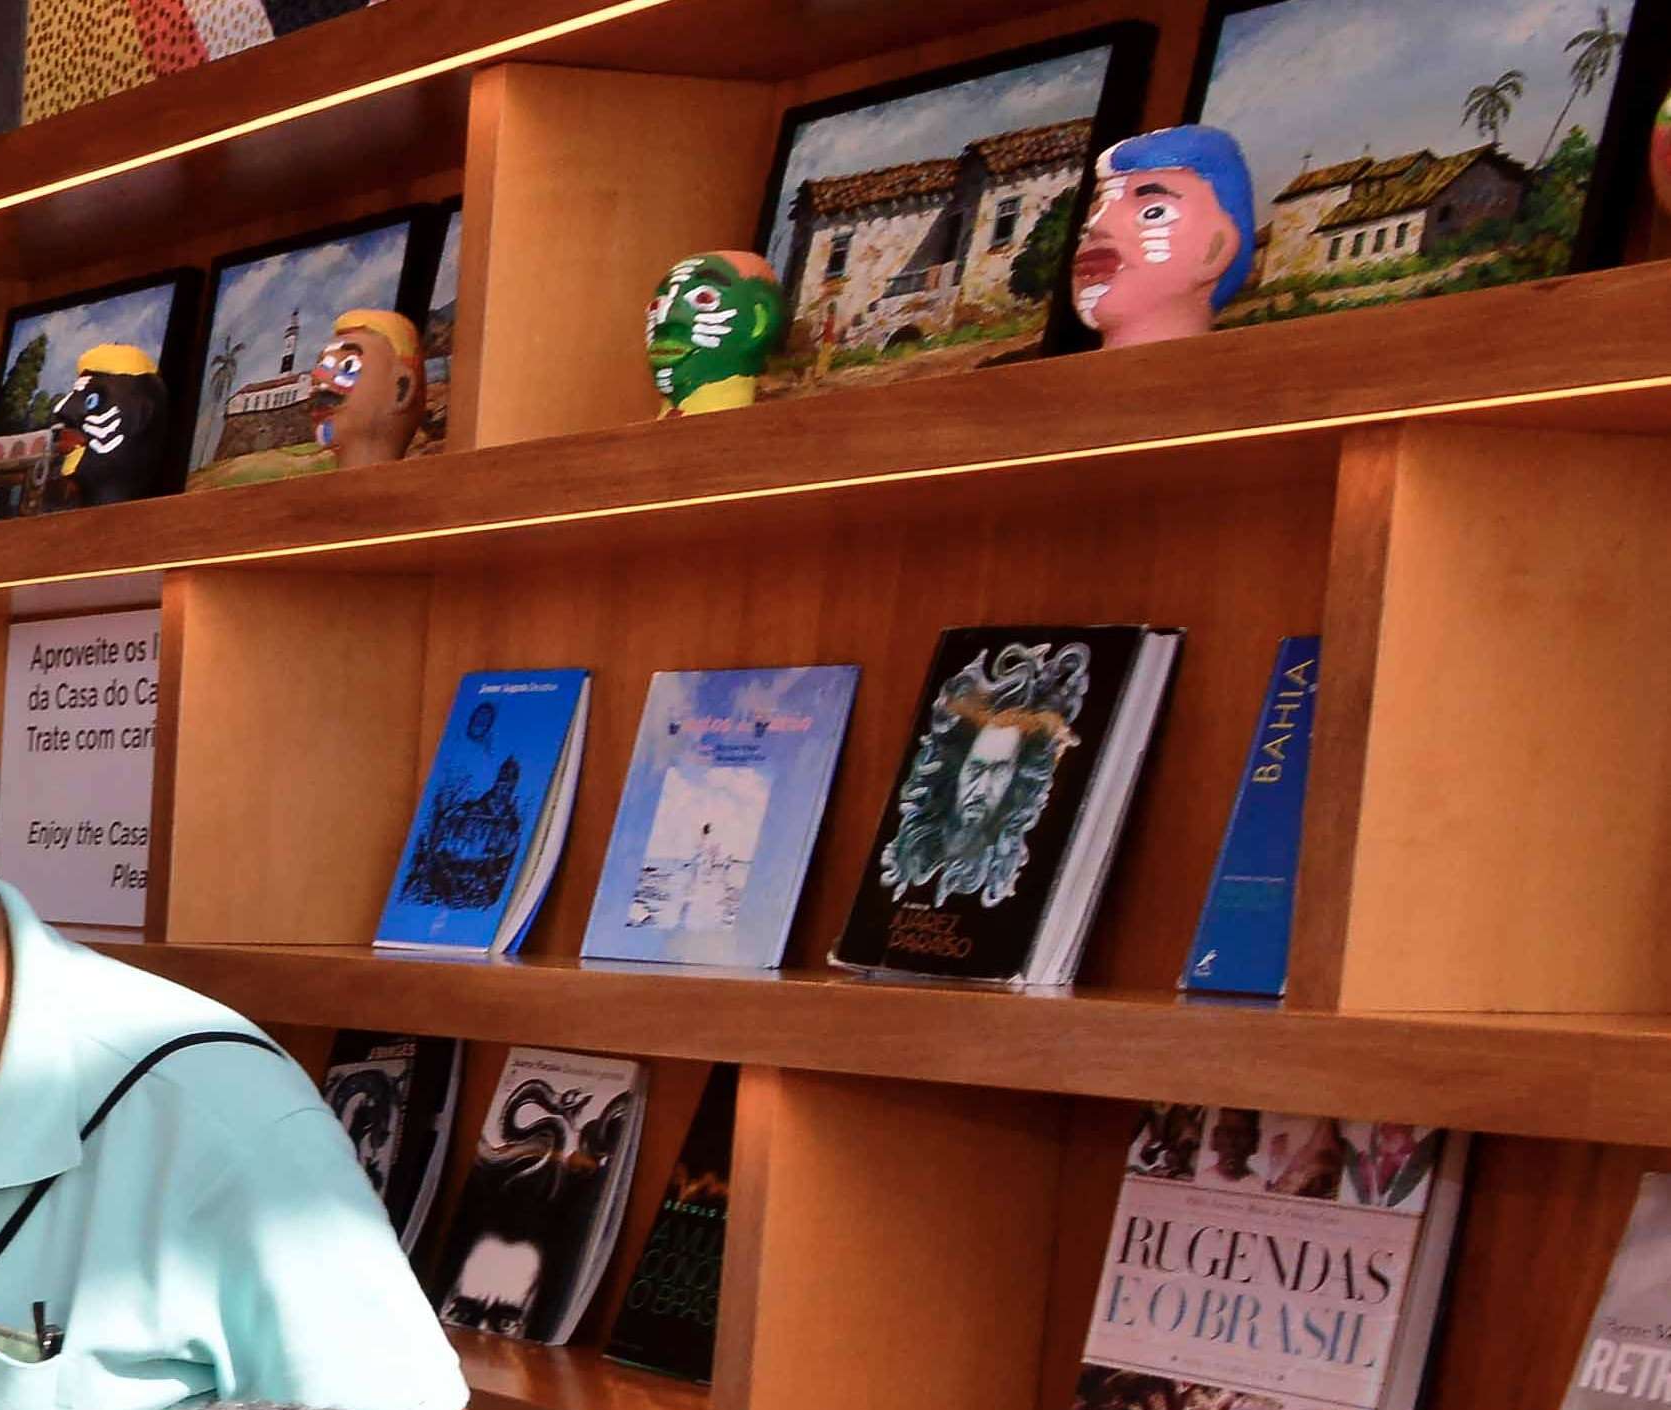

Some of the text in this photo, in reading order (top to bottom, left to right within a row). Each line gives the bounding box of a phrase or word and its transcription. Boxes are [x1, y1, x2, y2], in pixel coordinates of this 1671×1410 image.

[29, 637, 119, 675] Aproveite
[124, 640, 147, 663] os
[27, 683, 50, 711] da
[56, 682, 99, 709] Casa
[104, 678, 129, 707] do
[26, 725, 71, 752] Trate
[75, 728, 115, 750] com
[1251, 659, 1316, 783] BAHIA
[26, 820, 149, 851] Enjoy the Casa
[110, 863, 149, 890] Plea
[1116, 1216, 1395, 1305] RUGENDAS
[1104, 1274, 1142, 1326] E
[1147, 1281, 1188, 1332] O
[1191, 1288, 1377, 1368] BRASIL
